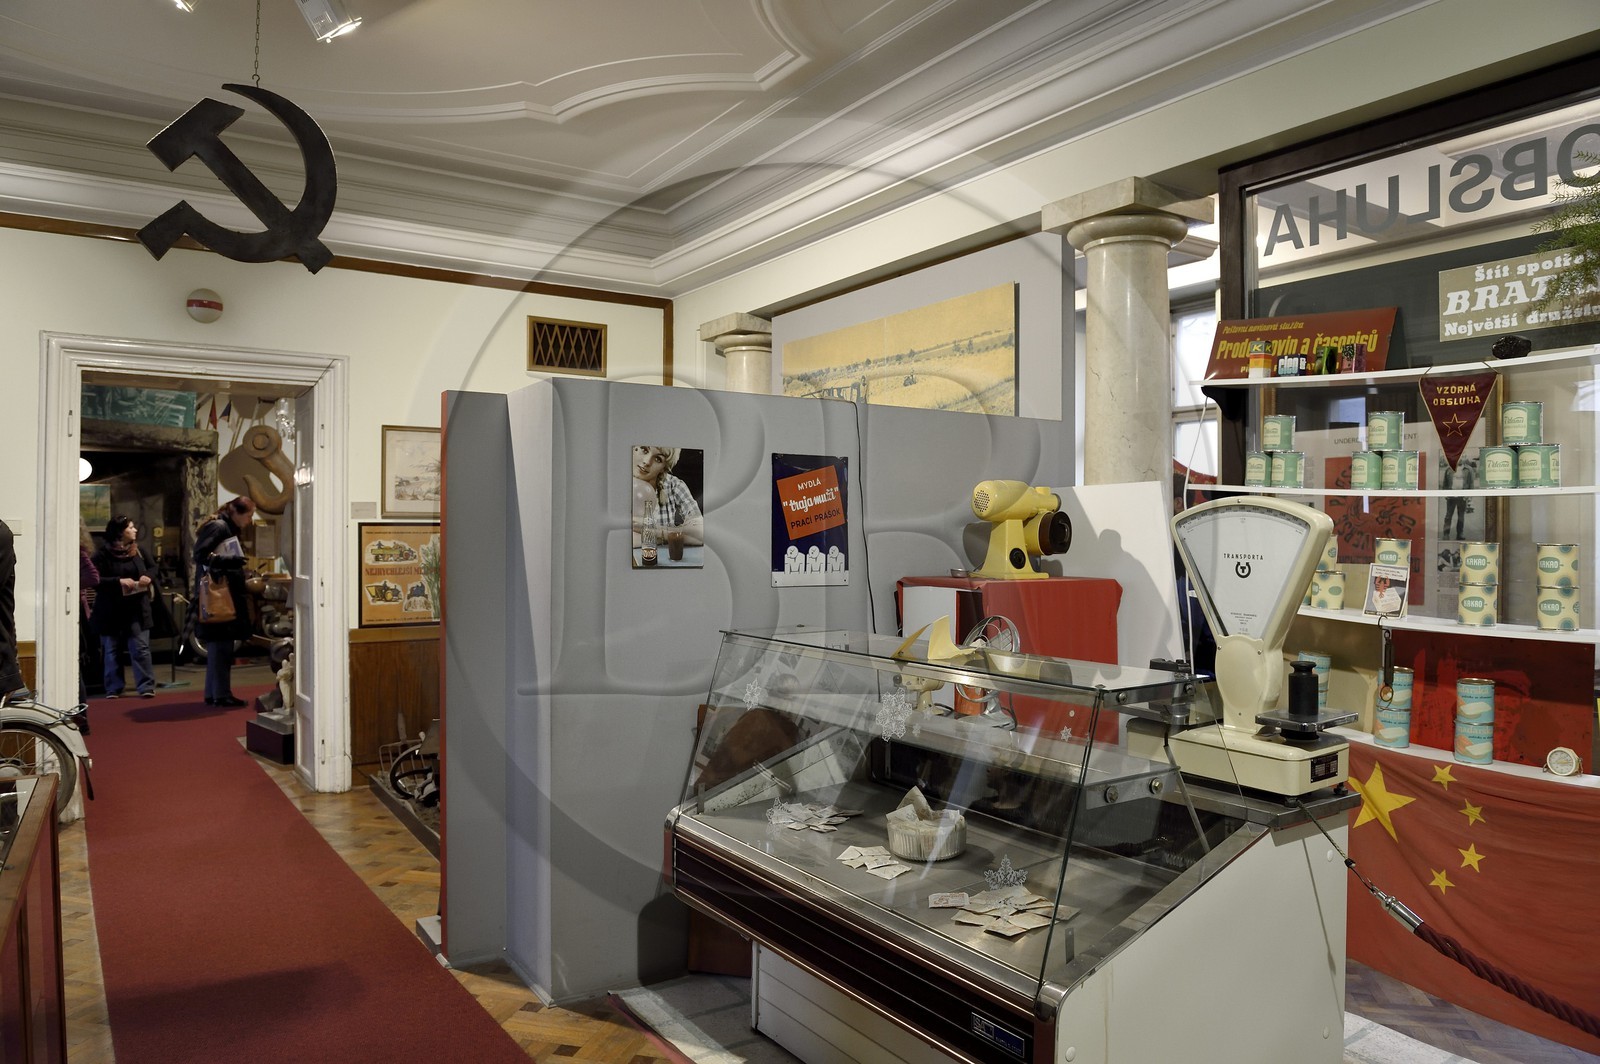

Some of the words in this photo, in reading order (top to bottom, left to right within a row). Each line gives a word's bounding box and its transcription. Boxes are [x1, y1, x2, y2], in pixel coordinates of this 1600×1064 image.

[1475, 264, 1510, 283] Štít
[1516, 249, 1597, 276] spotře
[1444, 312, 1519, 337] Největší
[1301, 337, 1311, 355] a
[1436, 383, 1476, 395] VZORNÁ
[1432, 395, 1481, 406] OBSLUHA
[1223, 552, 1264, 561] TRANSPORTA
[1379, 552, 1397, 562] KAKAO
[1466, 557, 1486, 567] KAKAO
[1539, 558, 1559, 569] KAKAO
[1463, 598, 1483, 608] KAKAO
[1540, 602, 1560, 612] KAKAO
